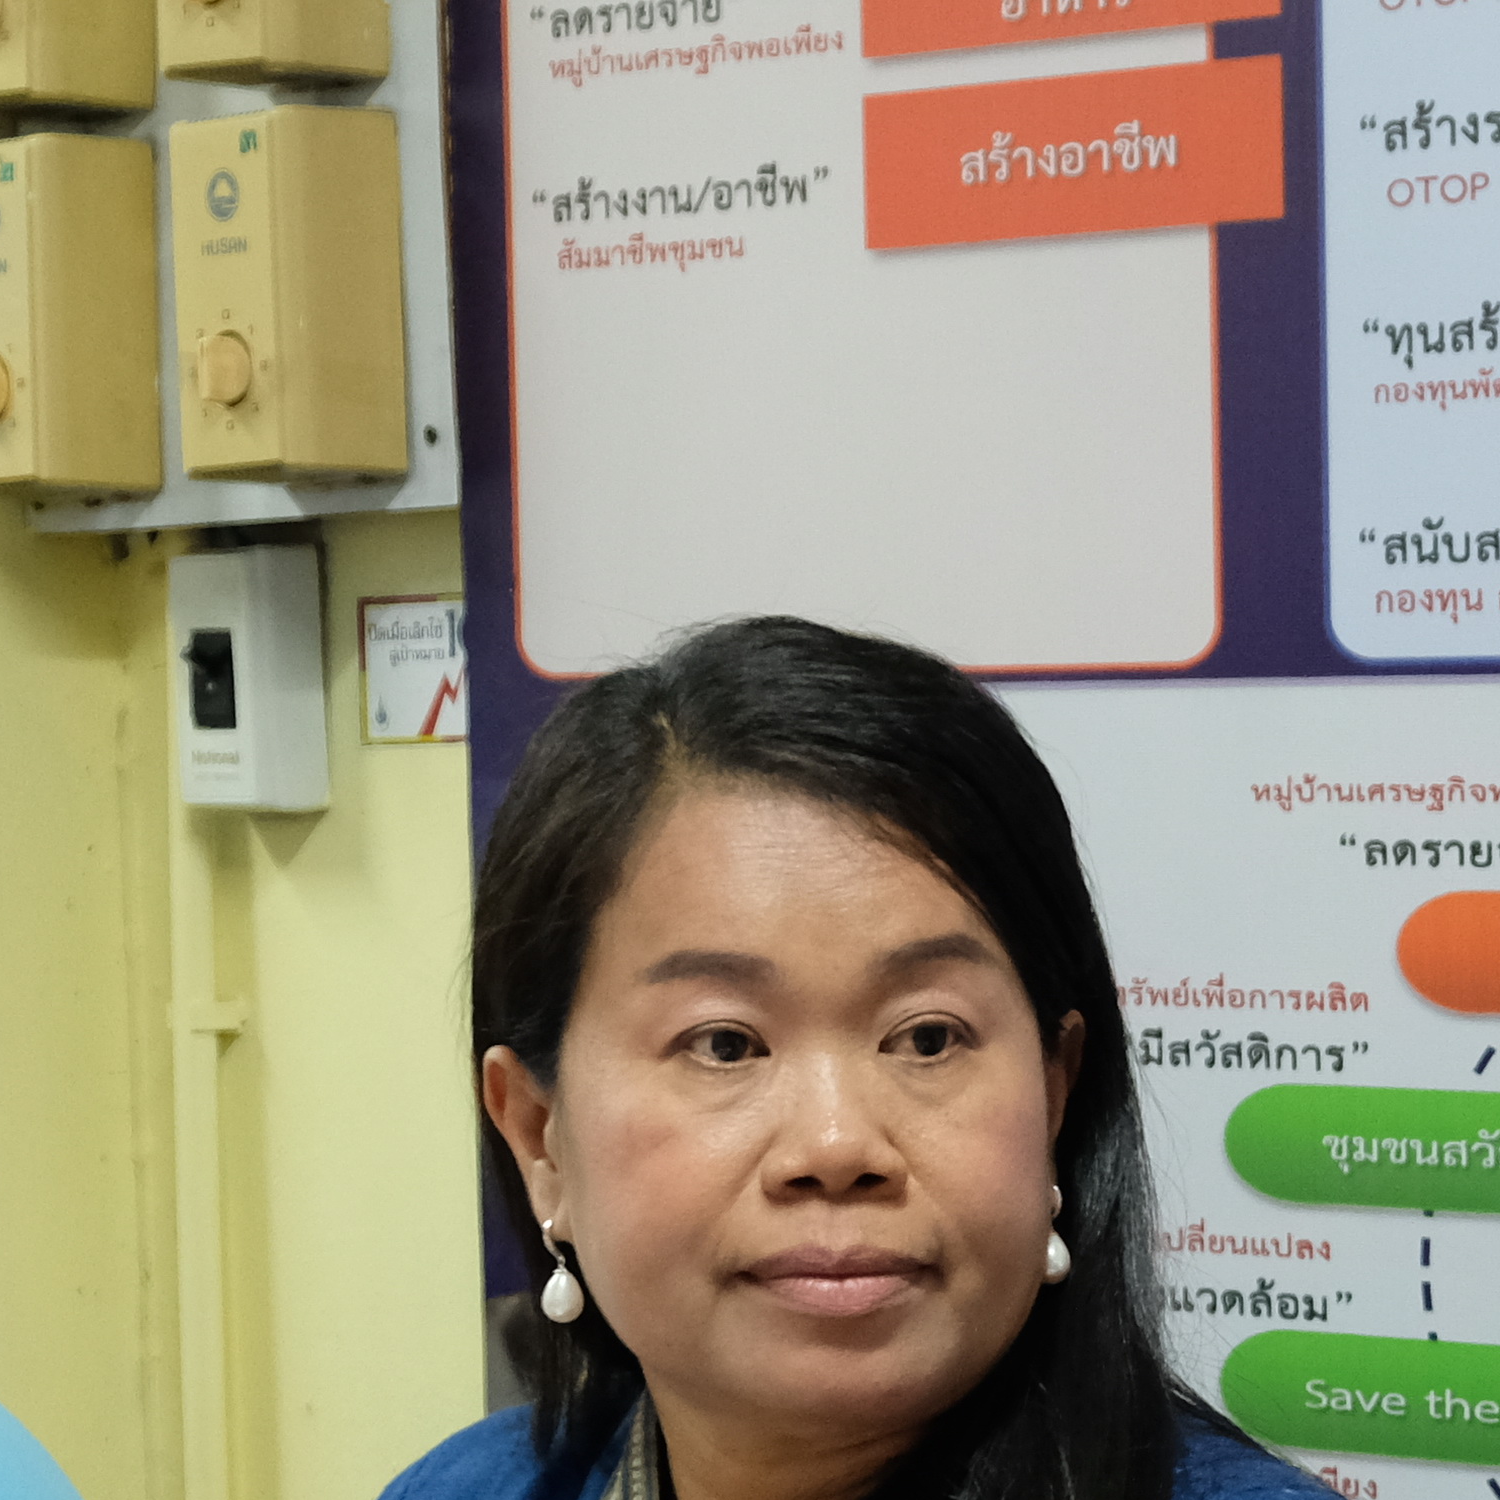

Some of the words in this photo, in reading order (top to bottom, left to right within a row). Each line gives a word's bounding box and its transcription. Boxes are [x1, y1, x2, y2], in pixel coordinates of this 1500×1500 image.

[959, 120, 1178, 187] สร้างอาชีพ
[1387, 172, 1490, 207] OTOP
[557, 231, 745, 273] สัมมาชีพชุมชน
[1375, 587, 1484, 623] กองทุน
[1305, 1378, 1406, 1418] Save
[1425, 1388, 1500, 1425] the
